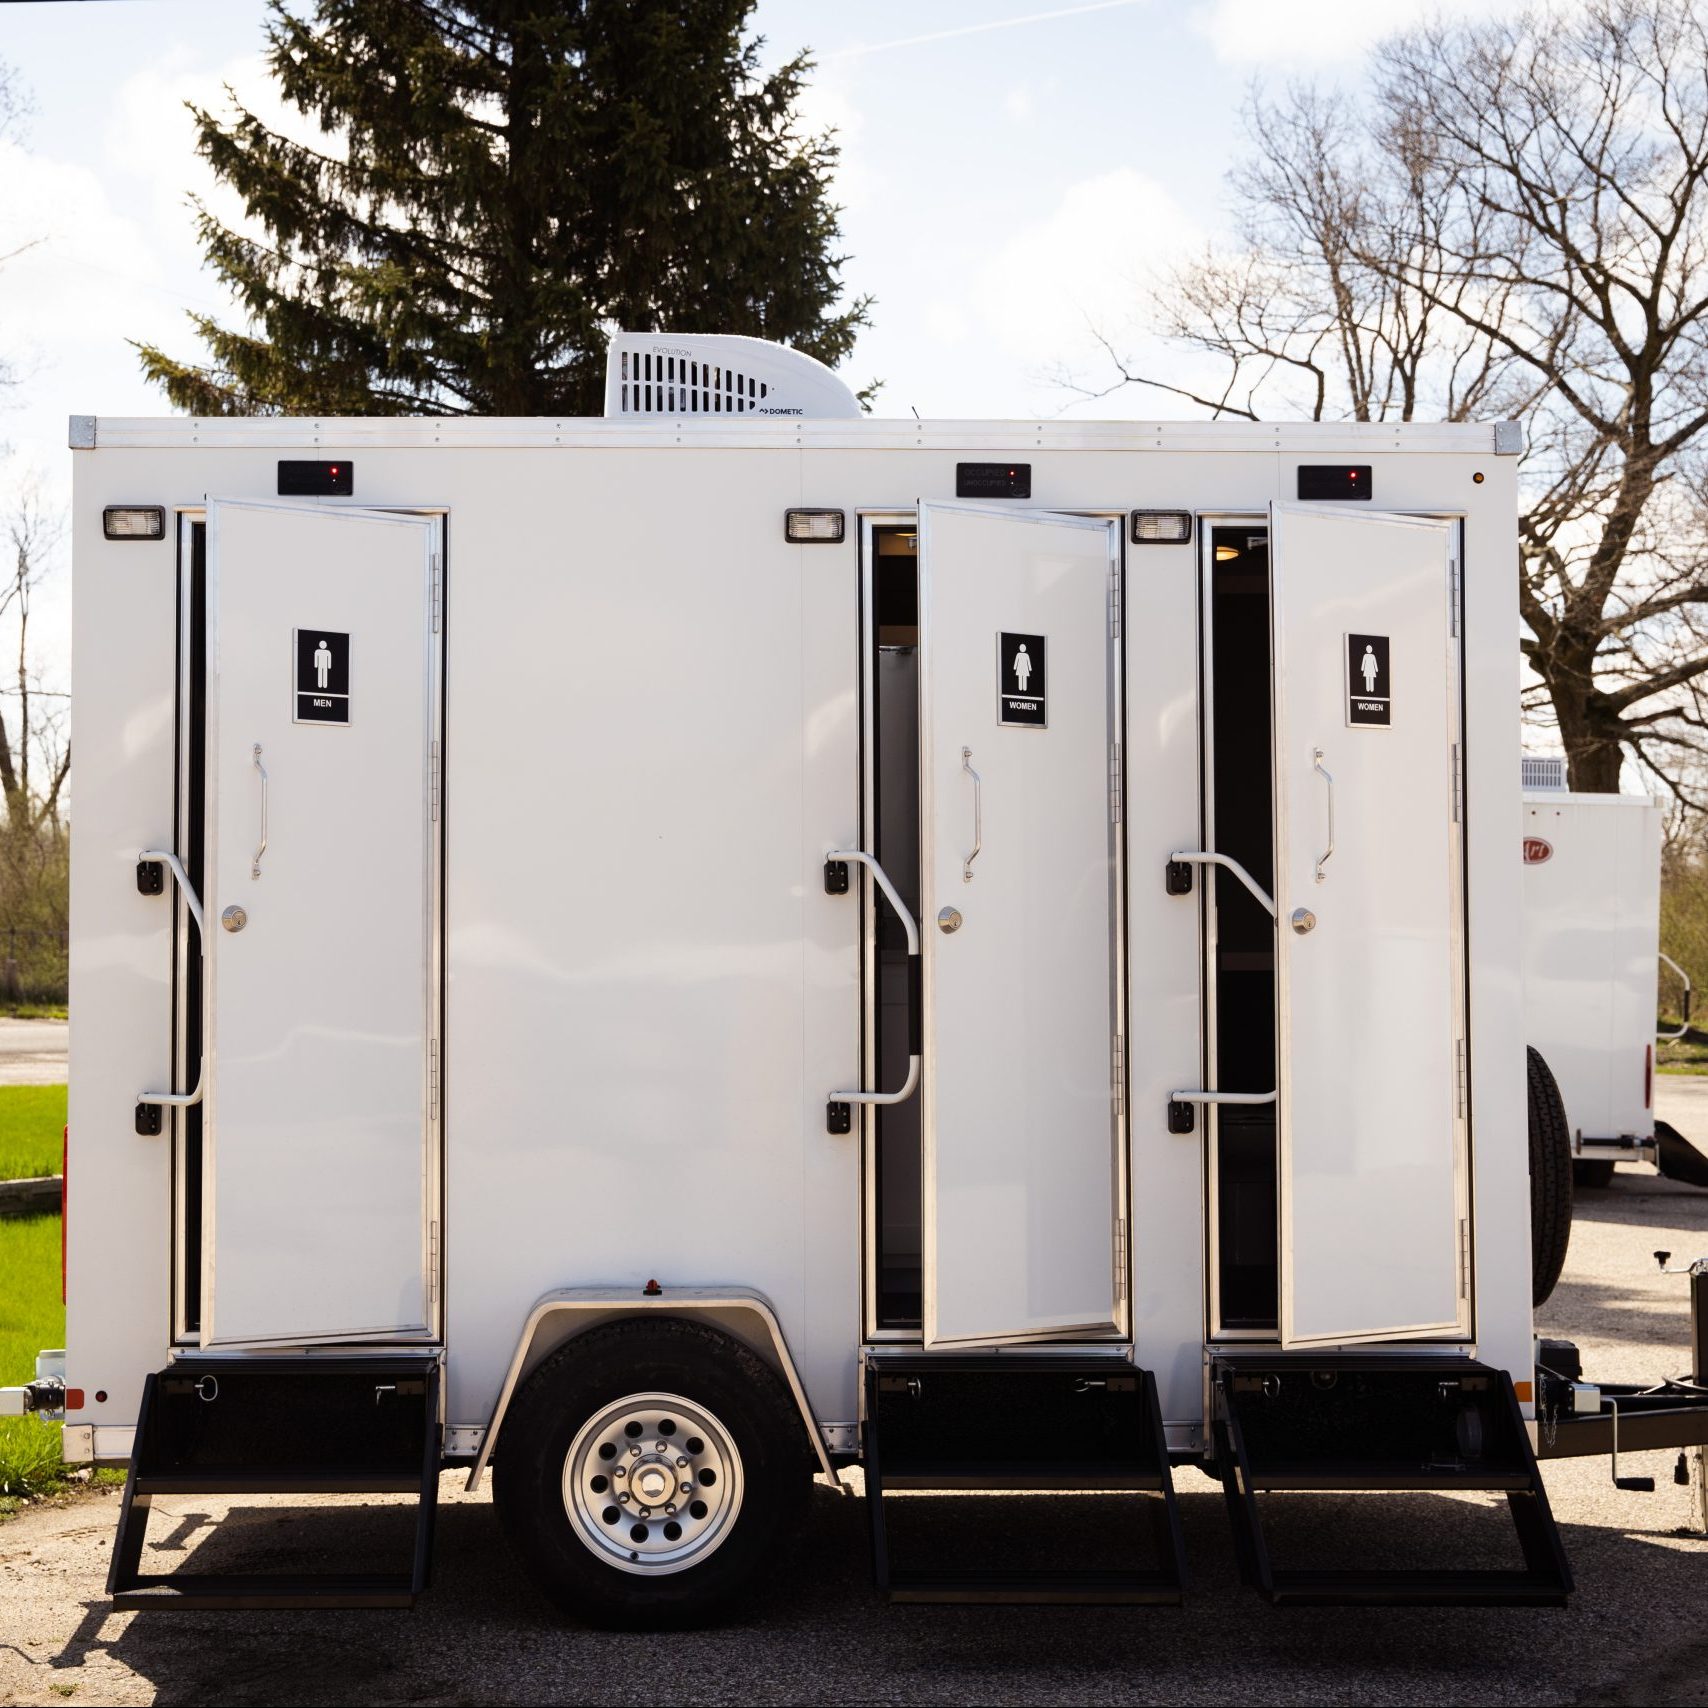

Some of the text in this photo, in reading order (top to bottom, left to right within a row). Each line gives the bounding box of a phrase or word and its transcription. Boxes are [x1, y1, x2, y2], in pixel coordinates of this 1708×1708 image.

[652, 346, 692, 357] EVOLUTION
[313, 698, 332, 708] MEN
[1009, 701, 1037, 711] WOMEN
[1357, 702, 1384, 711] WOMEN
